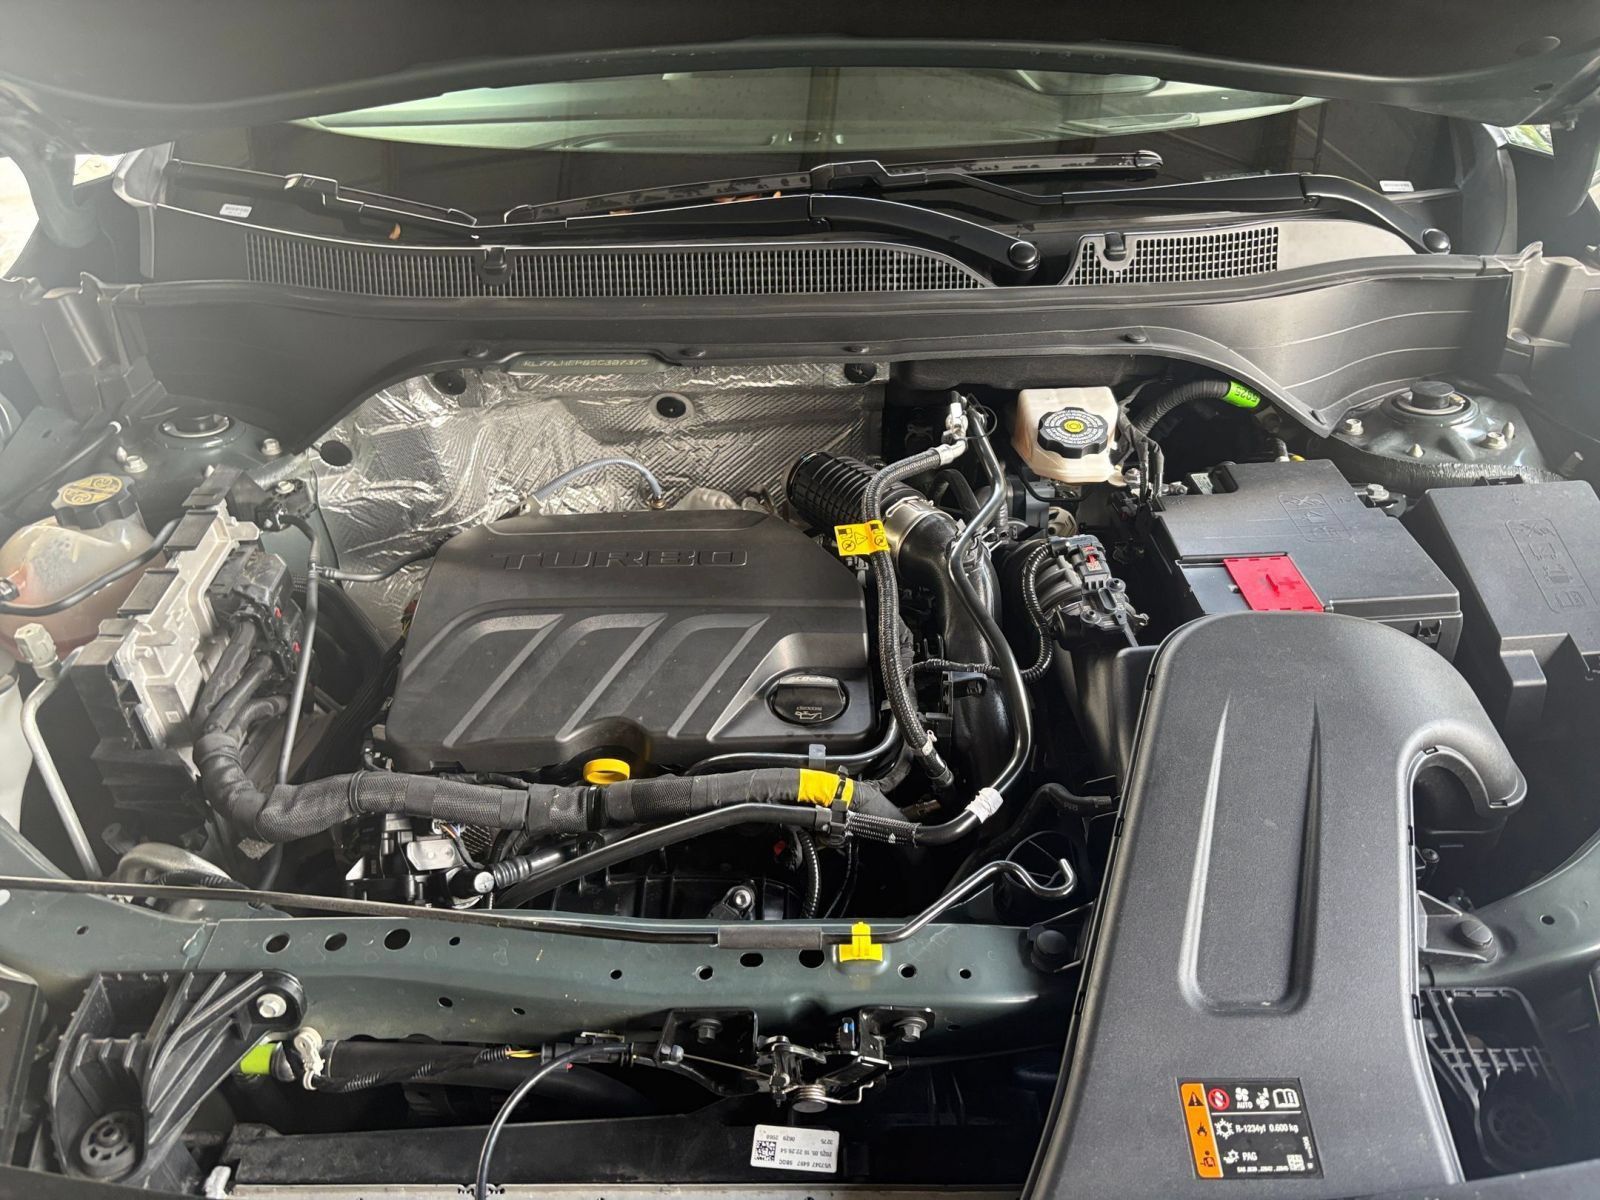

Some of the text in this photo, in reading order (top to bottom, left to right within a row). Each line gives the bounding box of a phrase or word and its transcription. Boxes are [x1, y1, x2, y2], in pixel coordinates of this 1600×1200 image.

[490, 551, 748, 570] TURBO
[1236, 1101, 1254, 1110] AUTO
[1288, 1123, 1299, 1134] kg
[1242, 1151, 1258, 1161] PAG
